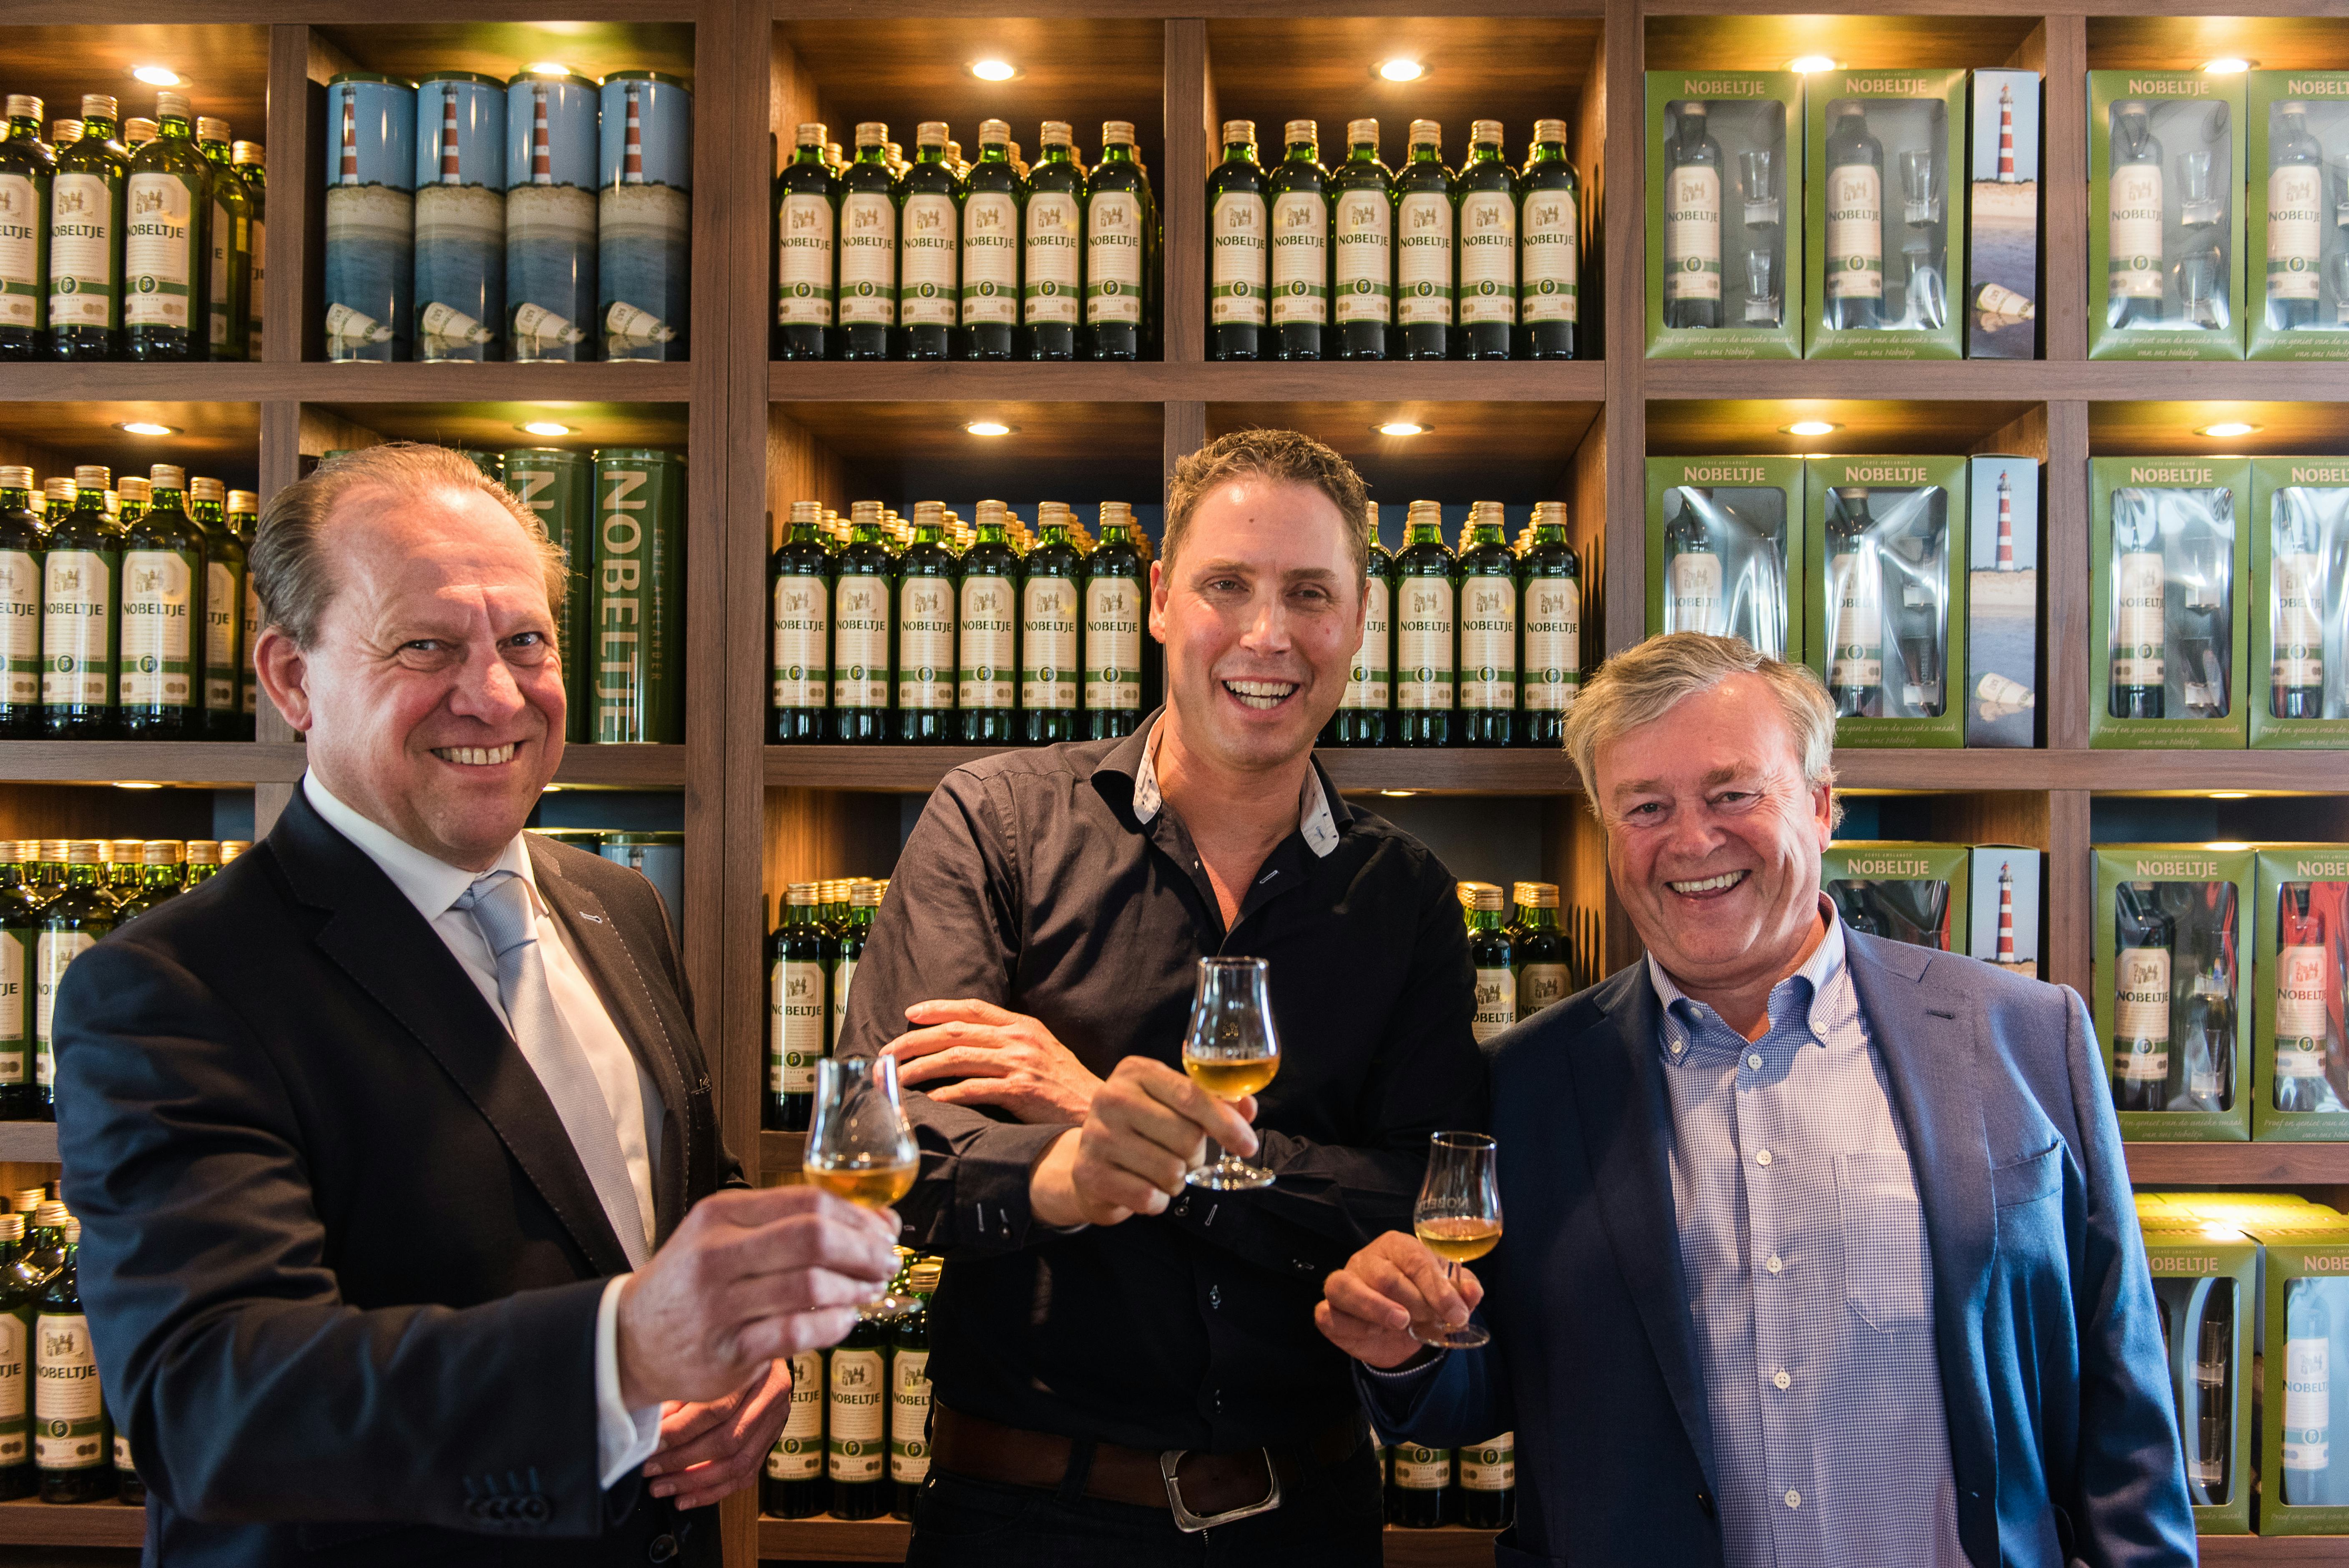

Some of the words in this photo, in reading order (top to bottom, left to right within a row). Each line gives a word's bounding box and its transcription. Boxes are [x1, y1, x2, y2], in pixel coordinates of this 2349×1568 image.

[1685, 80, 1765, 96] NOBELTJE
[1846, 78, 1927, 95] NOBELTJE
[2129, 80, 2209, 96] NOBELTJE
[2112, 209, 2162, 222] NOBELTJE
[2269, 211, 2320, 223] NOBELTJE
[128, 224, 184, 238] NOBELTJE
[781, 237, 831, 250] NOBELTJE
[843, 236, 893, 249] NOBELTJE
[904, 236, 955, 250] NOBELTJE
[965, 235, 1014, 248] NOBELTJE
[1027, 235, 1076, 248] NOBELTJE
[1090, 235, 1138, 247] NOBELTJE
[1216, 236, 1265, 249] NOBELTJE
[1275, 235, 1324, 248] NOBELTJE
[1339, 234, 1388, 247] NOBELTJE
[1400, 235, 1450, 248] NOBELTJE
[1463, 235, 1513, 248] NOBELTJE
[1524, 234, 1574, 246] NOBELTJE
[1685, 467, 1765, 483] NOBELTJE
[1846, 467, 1927, 483] NOBELTJE
[2131, 467, 2213, 484] NOBELTJE
[2292, 467, 2349, 482] NOBEL
[653, 528, 665, 576] ECHTE
[595, 472, 647, 733] NOBELTJE
[45, 603, 103, 616] NOBELTJE
[124, 603, 186, 616] NOBELTJE
[775, 620, 824, 631] NOBELTJE
[837, 620, 885, 631] NOBELTJE
[902, 621, 952, 633] NOBELTJE
[962, 621, 1011, 632] NOBELTJE
[1025, 621, 1074, 632] NOBELTJE
[1088, 621, 1138, 633] NOBELTJE
[1400, 621, 1451, 633] NOBELTJE
[1463, 620, 1513, 632] NOBELTJE
[1527, 622, 1577, 634] NOBELTJE
[559, 594, 571, 680] MELANDER
[651, 586, 665, 680] AMELANDER
[1847, 725, 1871, 734] geniet
[1886, 736, 1917, 747] Nobeltje
[1848, 859, 1929, 877] NOBELTJE
[2137, 861, 2218, 878] NOBELTJE
[2117, 990, 2168, 1003] NOBELTJE
[2278, 989, 2326, 1000] NOBELTJE
[772, 1003, 822, 1017] NOBELTJE
[1472, 1012, 1514, 1024] OBELTJE
[38, 1364, 96, 1380] NOBELTJE
[831, 1393, 880, 1405] NOBELTJE
